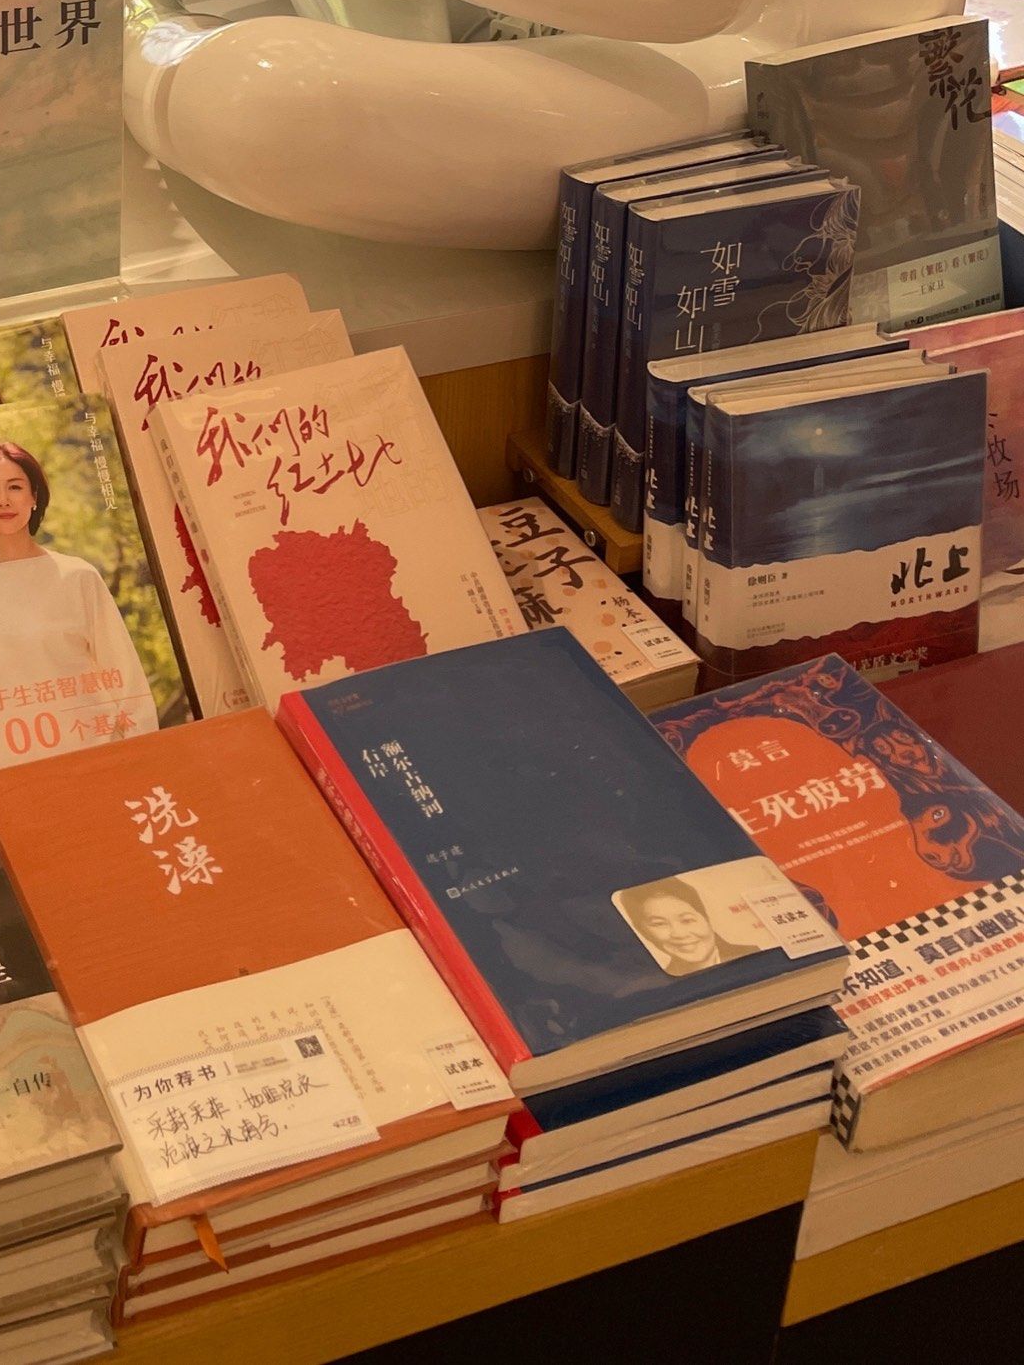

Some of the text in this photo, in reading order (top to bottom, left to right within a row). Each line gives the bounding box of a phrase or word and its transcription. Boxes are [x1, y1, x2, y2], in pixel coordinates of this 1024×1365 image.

[918, 28, 991, 131] 繁花
[700, 241, 742, 308] 如雪
[675, 285, 708, 353] 如山
[84, 412, 118, 511] 与幸福 慢慢相见
[986, 411, 1021, 502] 牧场
[890, 544, 971, 595] 北上
[890, 585, 970, 609] NORTHWARD
[381, 740, 444, 818] 额尔古纳河
[727, 740, 790, 773] 莫言
[124, 785, 223, 895] 洗澡
[444, 1057, 484, 1076] 试读本
